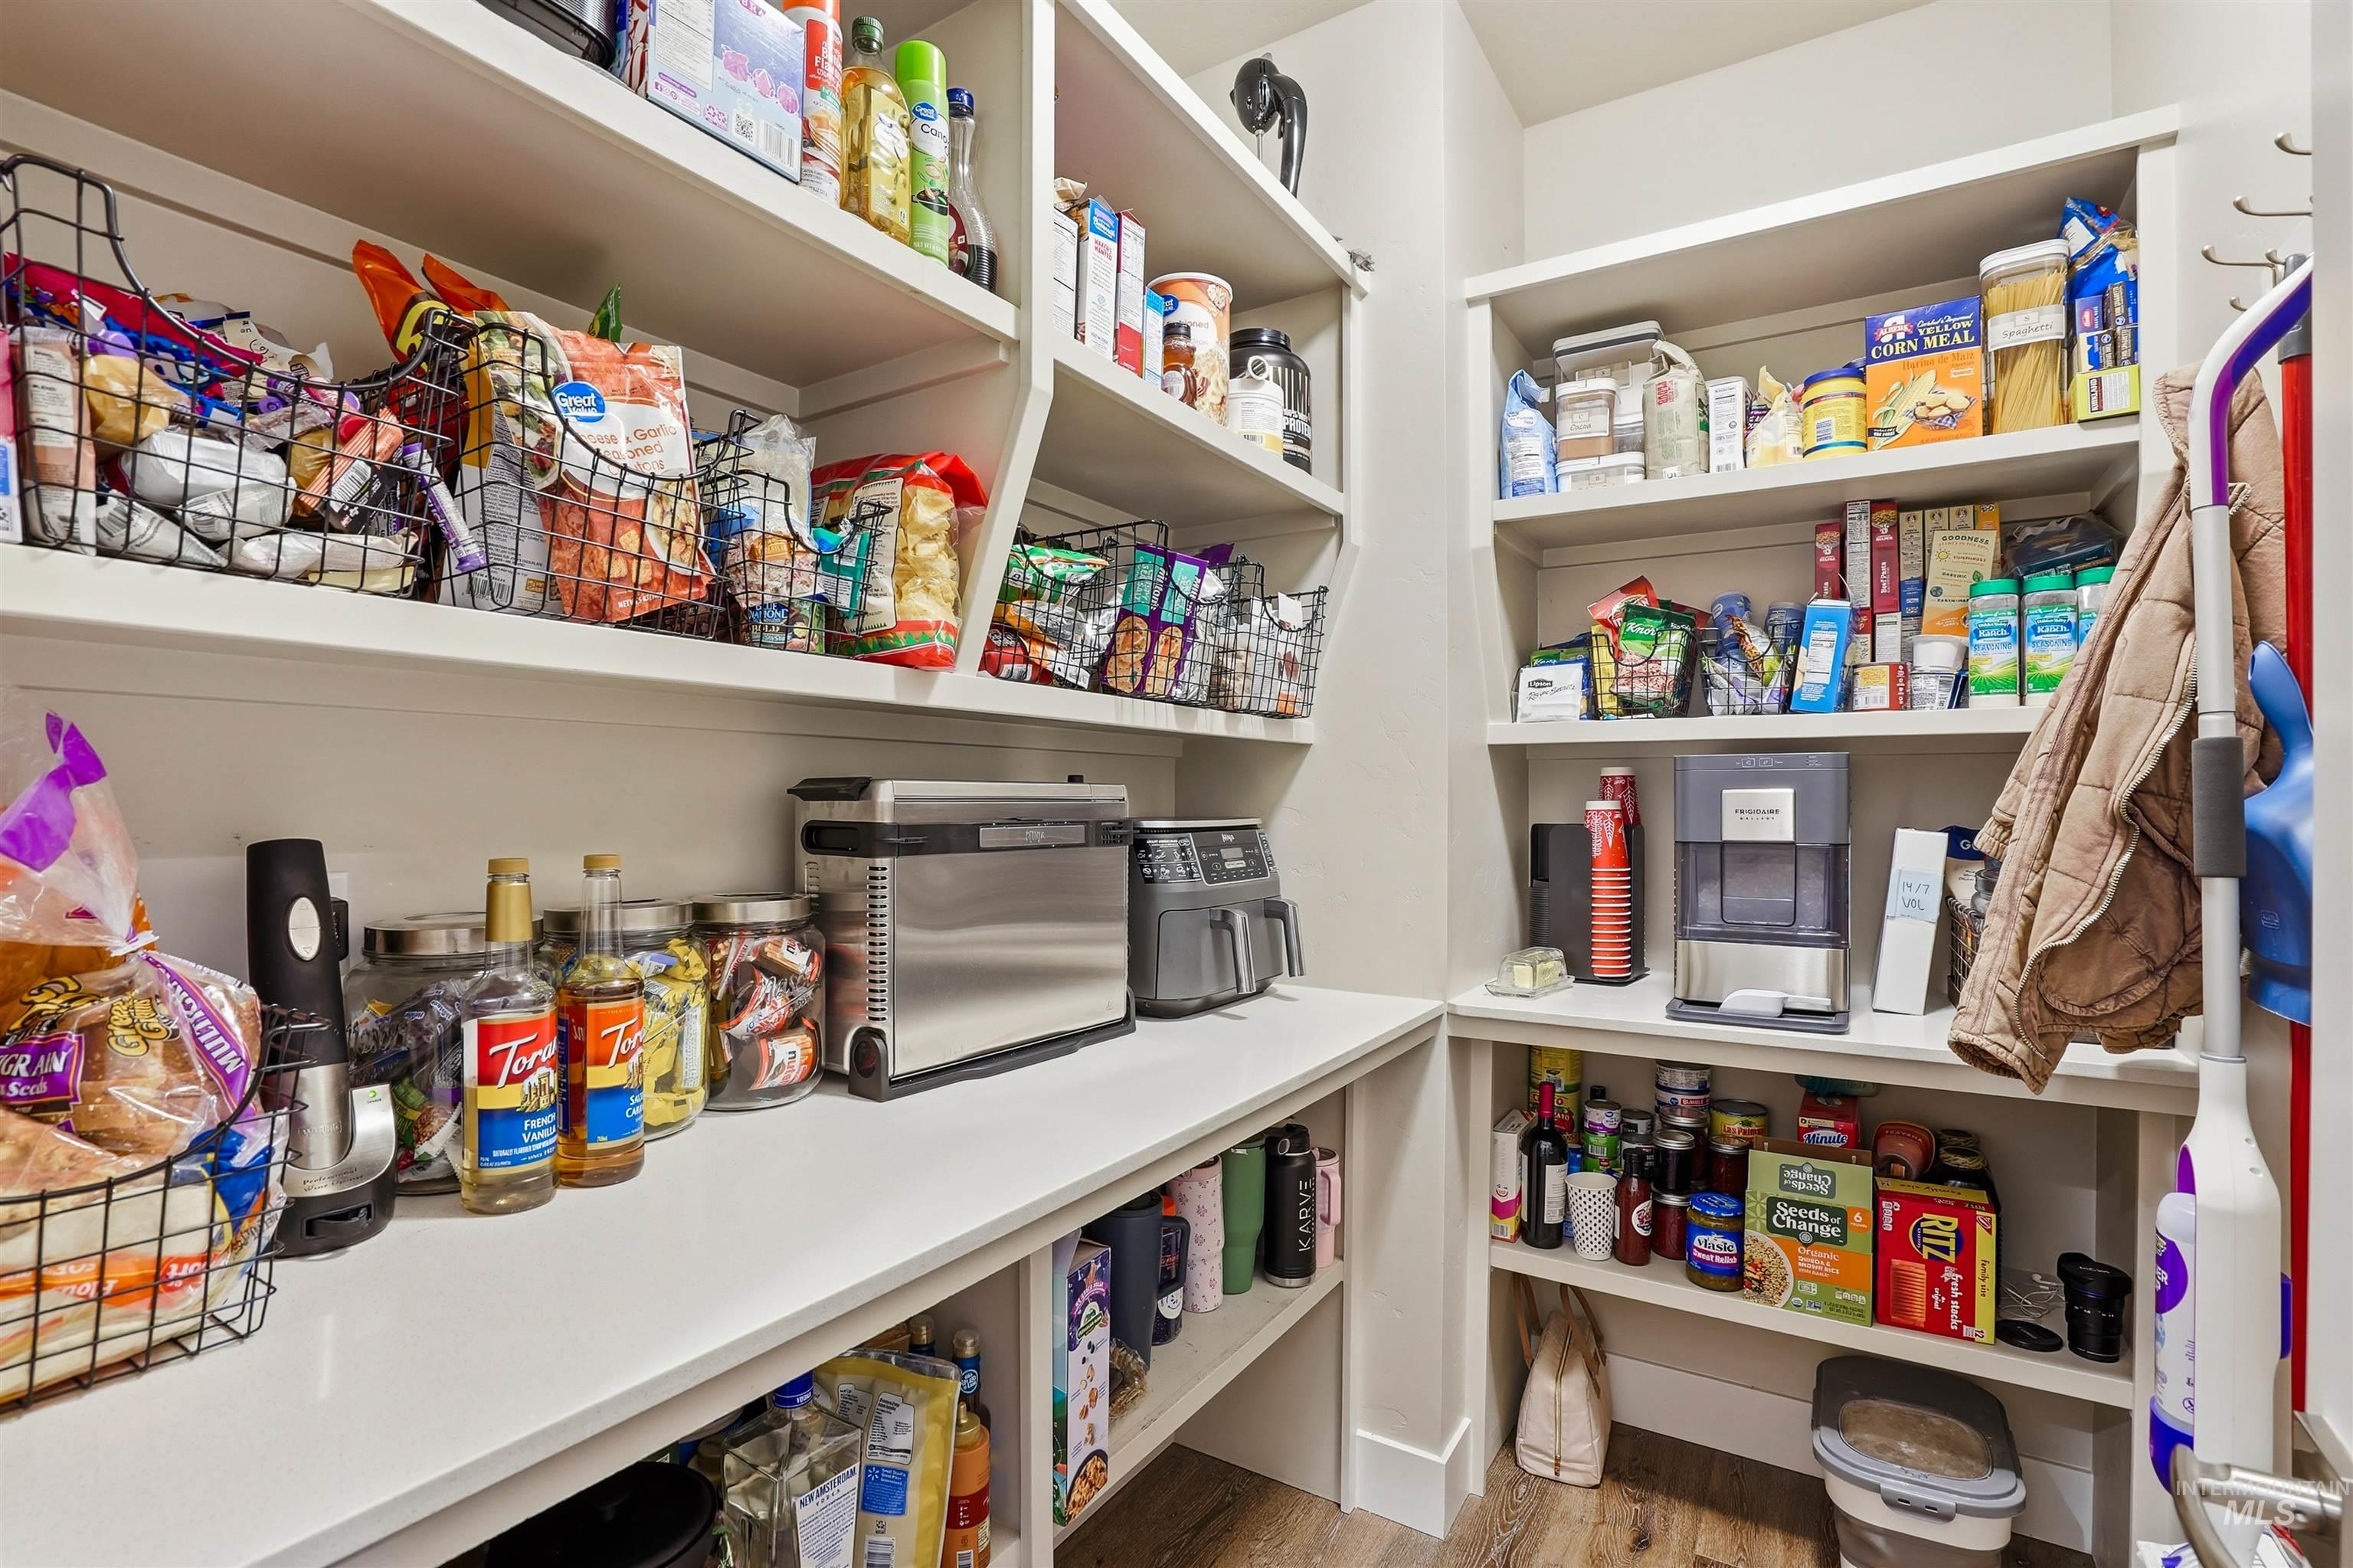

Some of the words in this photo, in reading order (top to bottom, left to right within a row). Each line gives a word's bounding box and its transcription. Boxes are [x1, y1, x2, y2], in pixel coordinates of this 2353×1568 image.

[1917, 320, 1974, 336] YELLOW
[2002, 322, 2054, 339] Spaghetti
[1871, 338, 1918, 359] CORN
[1923, 330, 1975, 350] MEAL
[1938, 355, 1949, 364] de
[555, 391, 597, 408] Great
[2090, 378, 2099, 411] KIRKLAND
[633, 424, 678, 442] Garlic
[1570, 423, 1592, 431] Cocoa
[1942, 535, 1989, 545] GOODNESS
[1973, 643, 2012, 653] SEASONING
[2031, 639, 2073, 649] SEASONING
[524, 1111, 556, 1131] FRENCH
[522, 1124, 557, 1144] VANILLA
[1805, 1133, 1848, 1145] Minute
[1783, 1169, 1831, 1187] Change
[1791, 1180, 1829, 1195] Seeds
[1299, 1178, 1312, 1252] KARVE
[1775, 1201, 1830, 1223] Seeds
[1854, 1212, 1863, 1223] 6
[1772, 1213, 1841, 1239] Change
[1697, 1238, 1735, 1252] Vlasic
[1919, 1213, 1959, 1264] RITZ
[1714, 1255, 1737, 1264] Relish
[1798, 1246, 1840, 1262] Organic
[1980, 1259, 1990, 1287] family
[1950, 1272, 1964, 1298] fresh
[1980, 1287, 1989, 1298] size
[1950, 1299, 1963, 1331] stacks
[799, 1494, 814, 1510] NEW
[814, 1465, 857, 1499] AMSTERDAM
